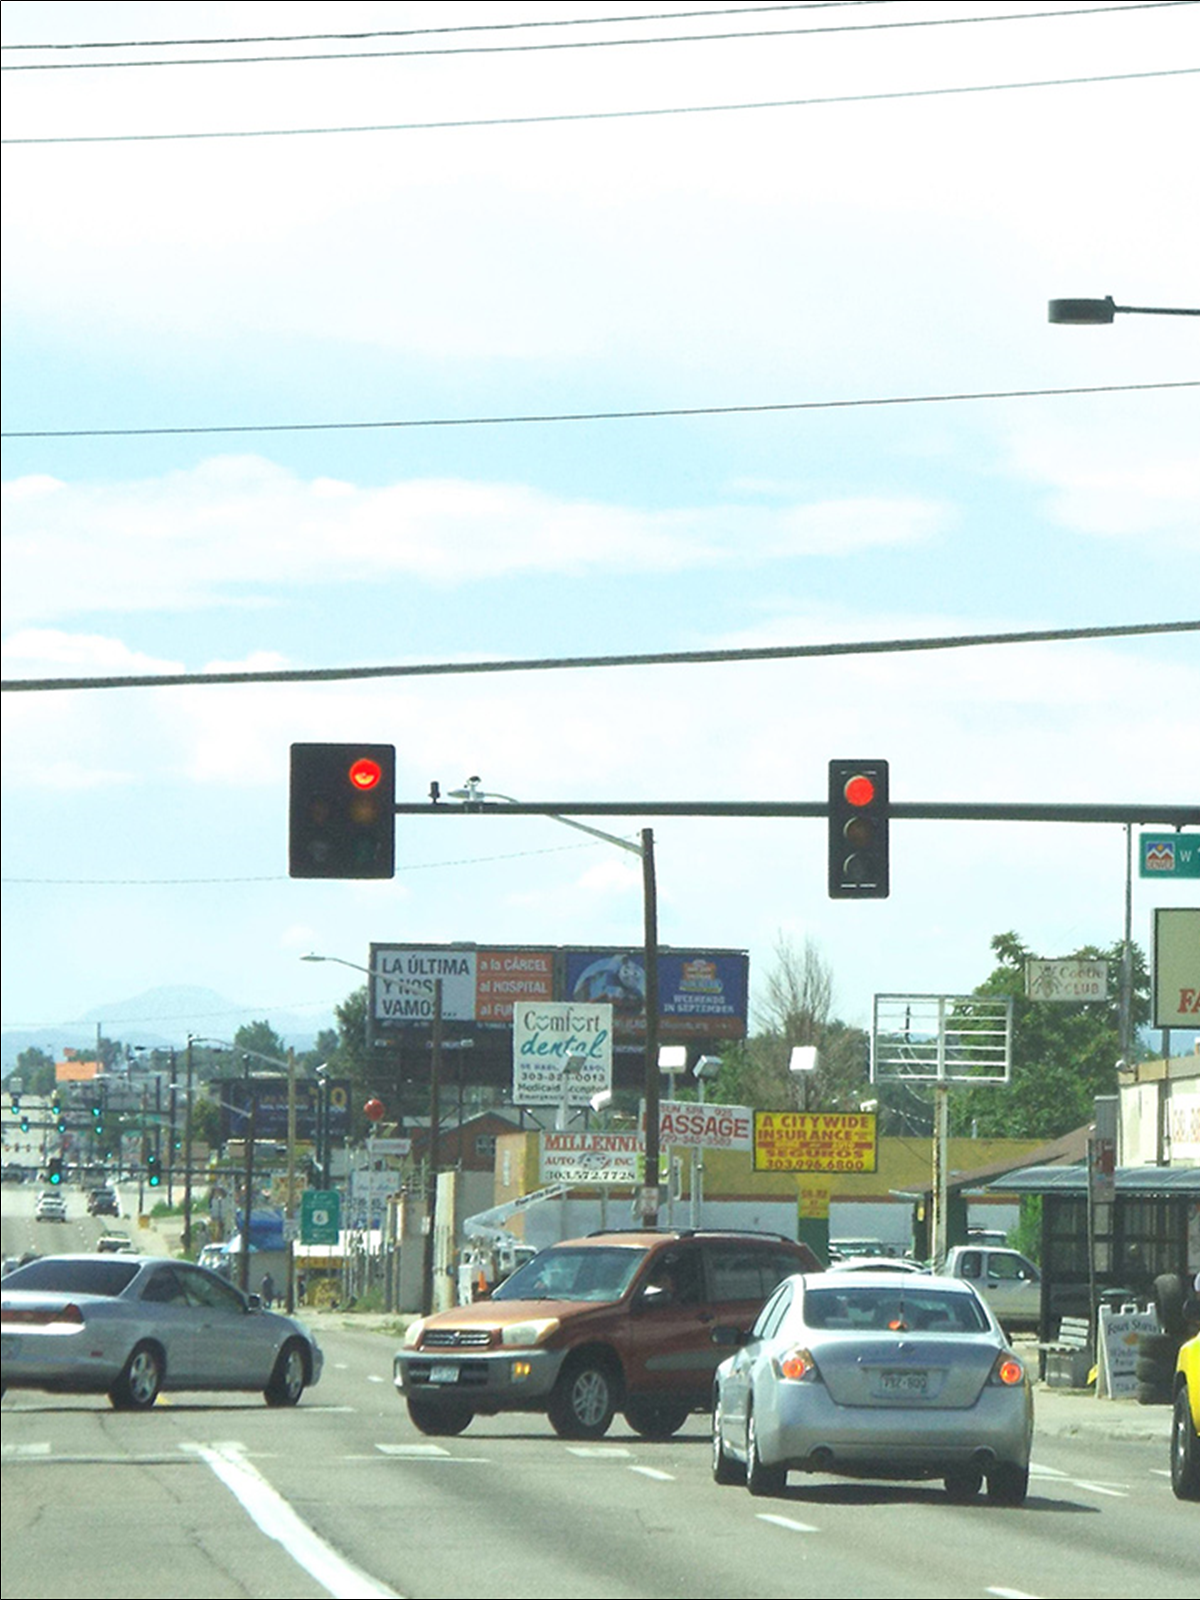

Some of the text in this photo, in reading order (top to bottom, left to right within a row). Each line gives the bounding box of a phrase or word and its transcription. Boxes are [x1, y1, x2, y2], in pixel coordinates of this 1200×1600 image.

[1180, 850, 1192, 862] W
[382, 954, 470, 975] LA ÚLTIMA
[382, 979, 392, 994] Y
[493, 981, 548, 993] HOSPITAL
[642, 1111, 750, 1139] ASSAGE
[762, 1115, 774, 1128] A
[758, 1130, 852, 1141] INSURANCE
[545, 1156, 576, 1166] AUTO
